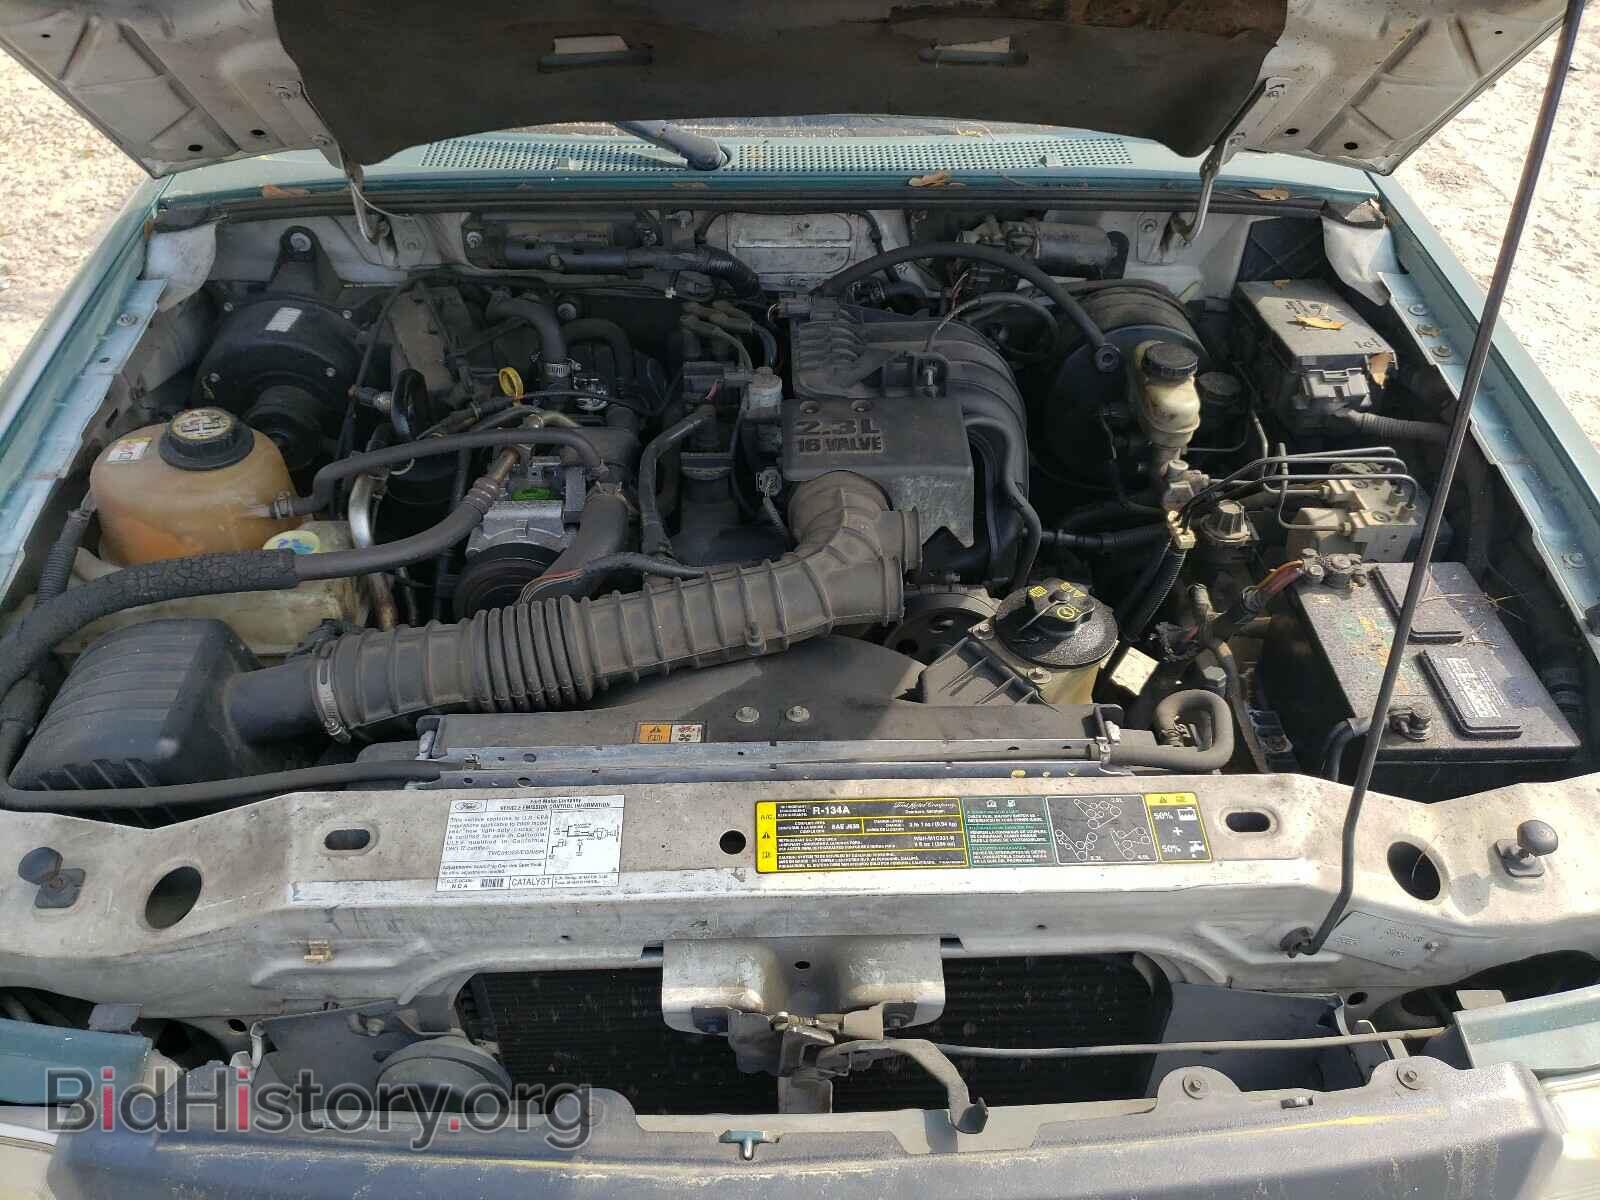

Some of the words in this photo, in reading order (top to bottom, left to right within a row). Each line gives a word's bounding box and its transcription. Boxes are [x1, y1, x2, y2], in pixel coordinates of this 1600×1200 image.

[796, 418, 880, 434] 2.3L
[825, 436, 883, 452] VALVE
[812, 805, 851, 815] R-134A
[1153, 811, 1174, 820] 50%
[1162, 844, 1182, 853] 50%
[511, 877, 550, 886] CATALYST
